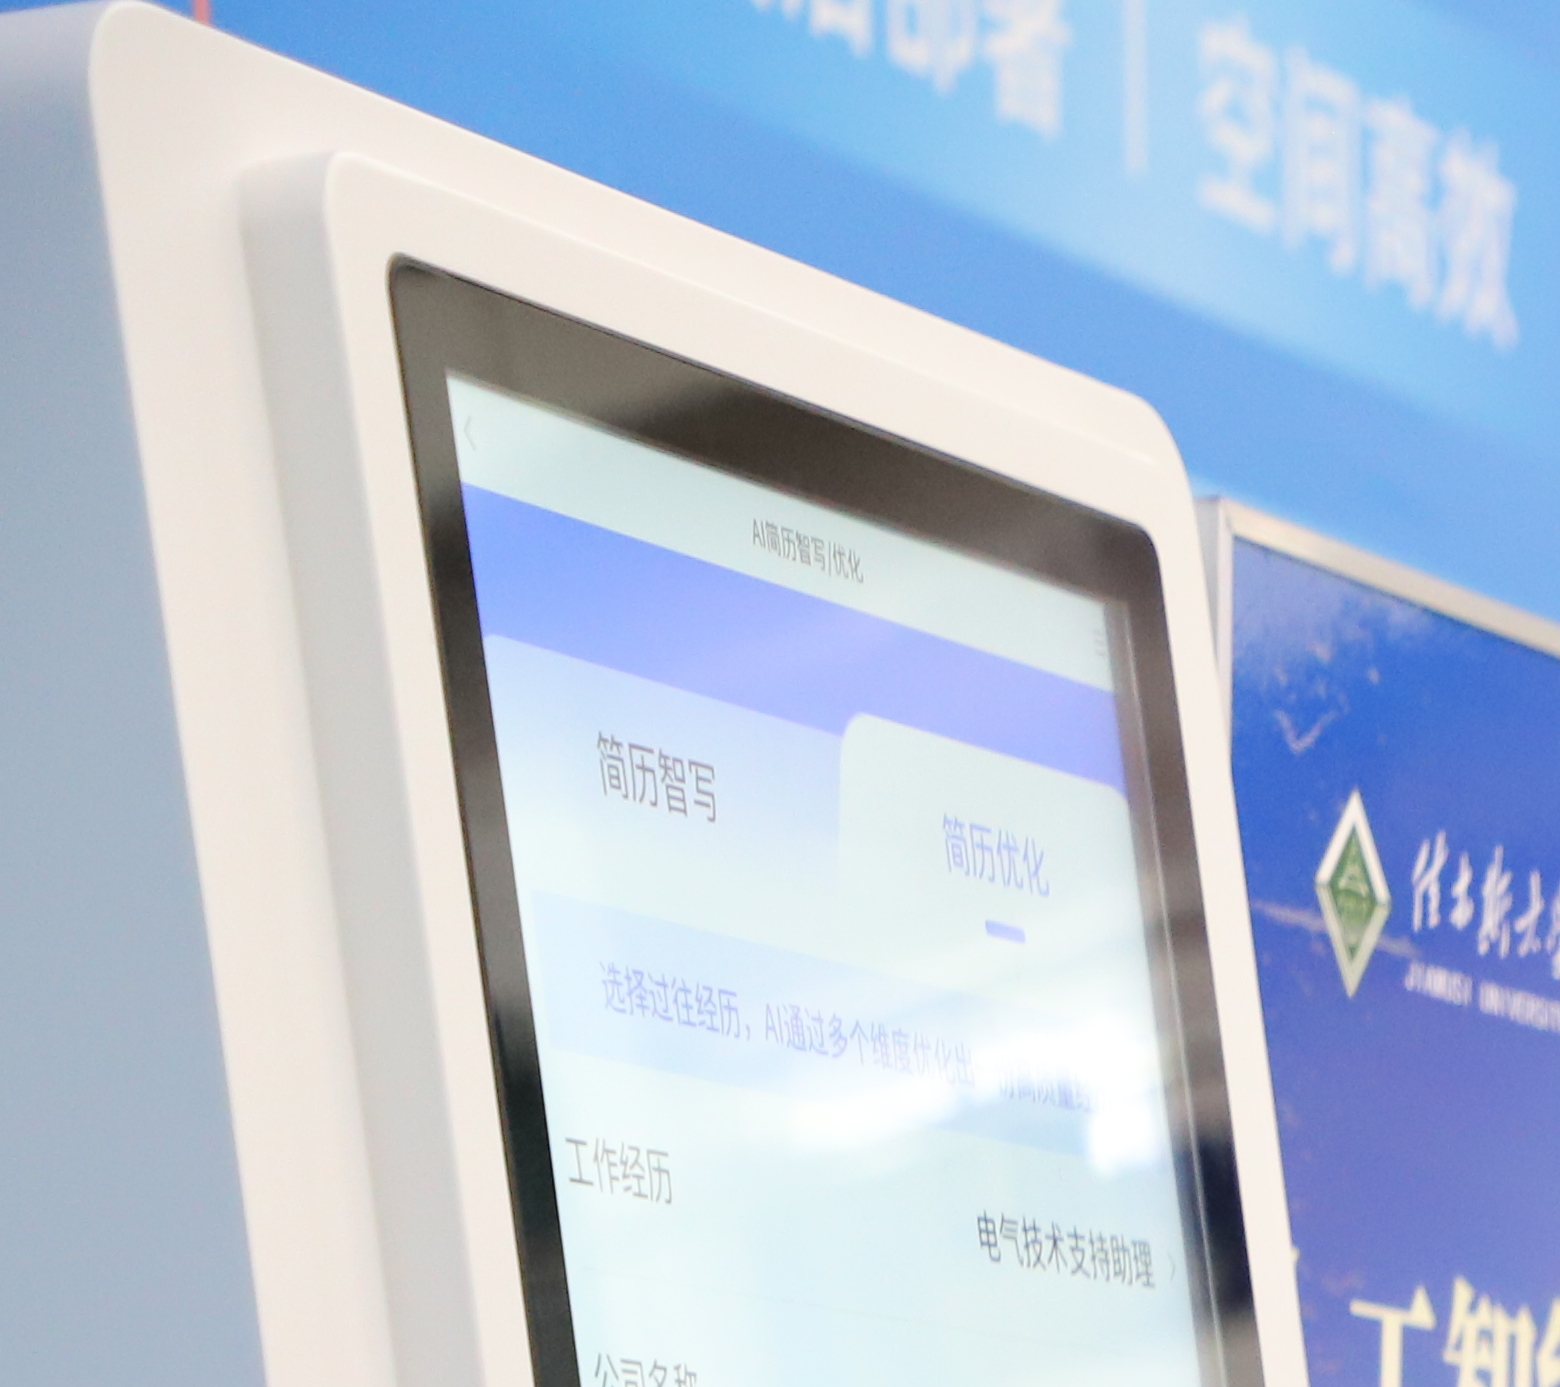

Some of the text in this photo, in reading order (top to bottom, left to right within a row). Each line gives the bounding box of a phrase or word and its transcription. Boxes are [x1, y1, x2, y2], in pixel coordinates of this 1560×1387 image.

[596, 730, 717, 823] 简历智写
[941, 813, 1050, 897] 简历优化
[565, 1137, 673, 1205] 工作经历
[977, 1211, 1156, 1289] 电气技术支持助理
